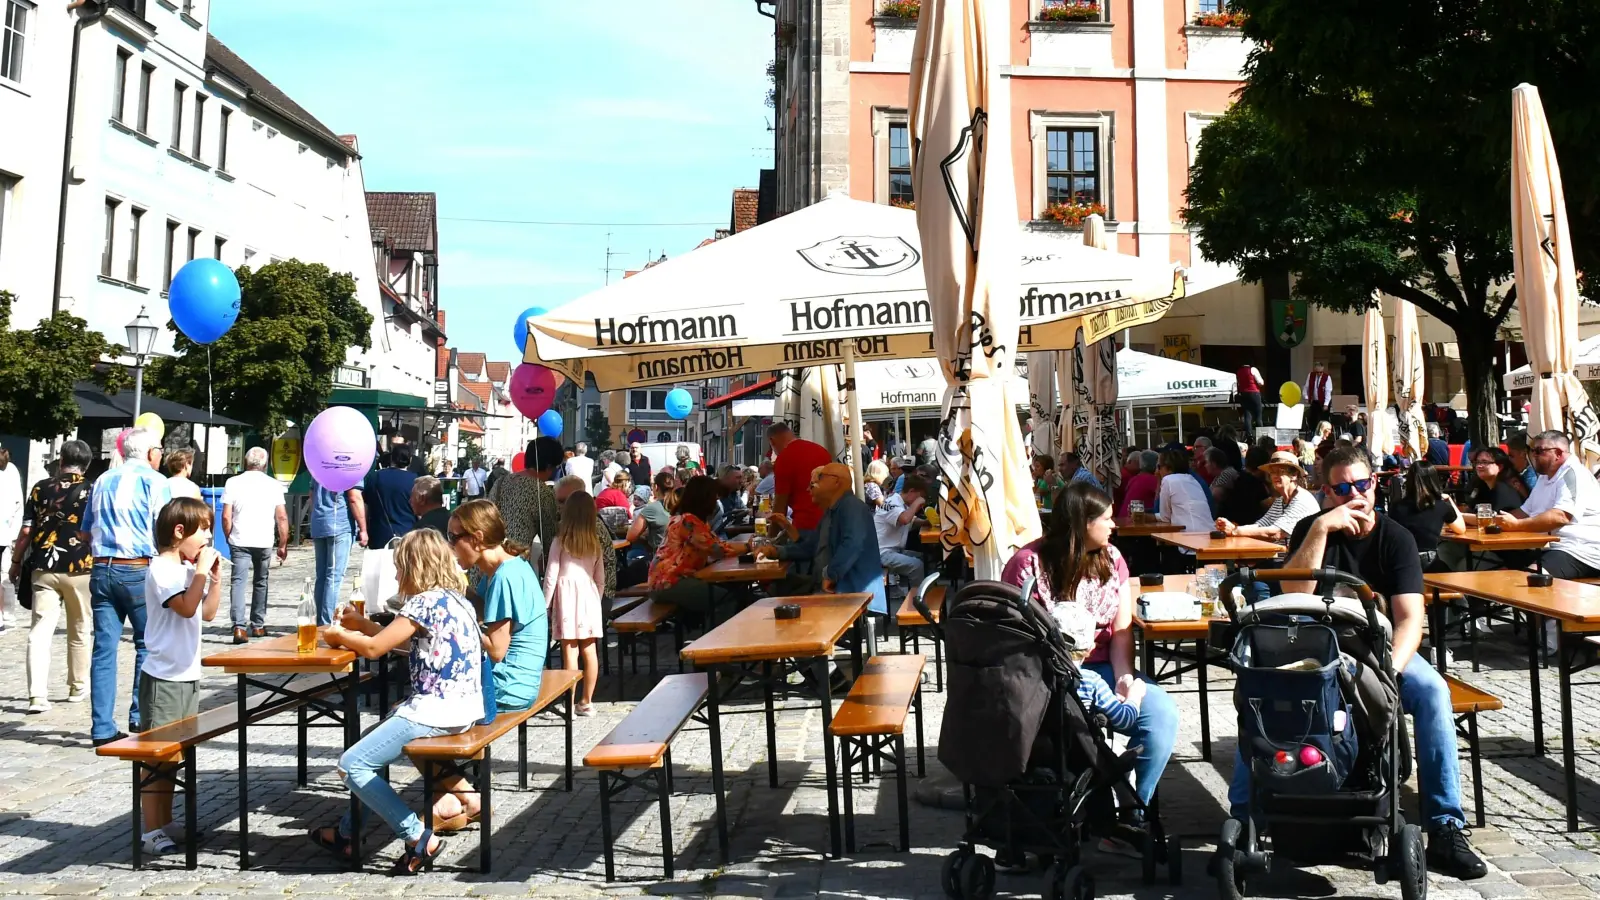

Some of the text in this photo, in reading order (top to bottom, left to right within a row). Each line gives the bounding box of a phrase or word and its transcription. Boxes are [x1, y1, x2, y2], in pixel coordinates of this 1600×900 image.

[790, 298, 931, 332] Hofmann
[594, 313, 737, 347] Hofmann
[1166, 379, 1217, 390] LOSCHER
[881, 391, 936, 404] Hofmann
